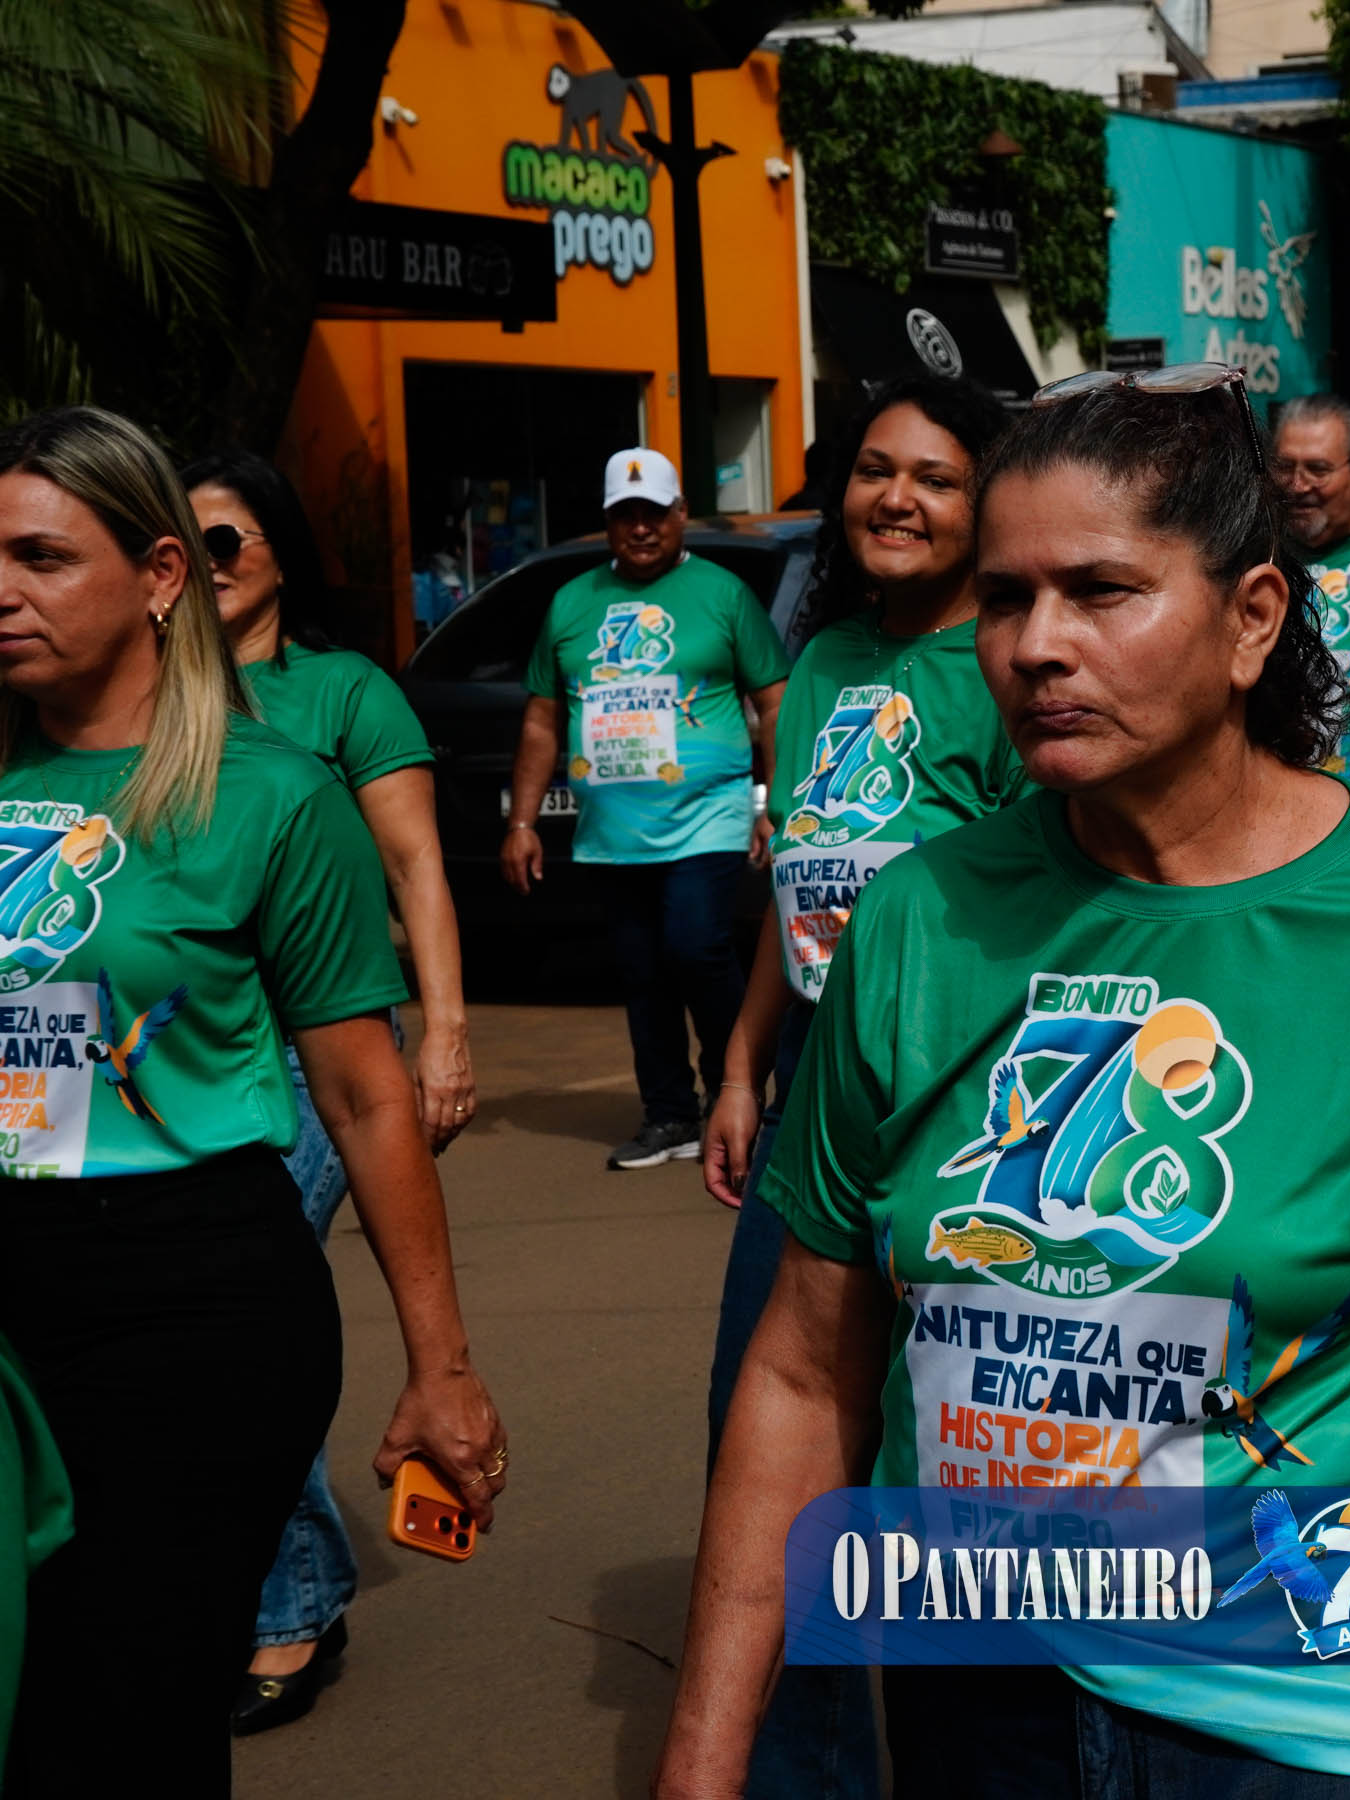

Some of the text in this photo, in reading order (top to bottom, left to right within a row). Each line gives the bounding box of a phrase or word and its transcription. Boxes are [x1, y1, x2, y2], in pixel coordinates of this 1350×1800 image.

[505, 143, 650, 216] macaco
[401, 240, 462, 287] BAR
[554, 210, 654, 284] prego
[1182, 245, 1269, 320] Bellas
[1205, 327, 1280, 395] Artes
[839, 687, 890, 707] BONITO
[804, 691, 921, 820] 78
[811, 826, 850, 846] ANOS
[776, 859, 857, 889] NATUREZA
[796, 885, 863, 911] ENCAN
[1032, 979, 1153, 1017] BONITO
[47, 1014, 86, 1036] QUE
[0, 1037, 83, 1071] ANTA,
[977, 998, 1252, 1242] 78
[1021, 1262, 1111, 1295] ANOS
[914, 1305, 1208, 1377] NATUREZA QUE
[970, 1359, 1197, 1427] ENCANTA,
[939, 1459, 1158, 1516] QUE INSPIRA,
[950, 1498, 1113, 1548] FUTURO
